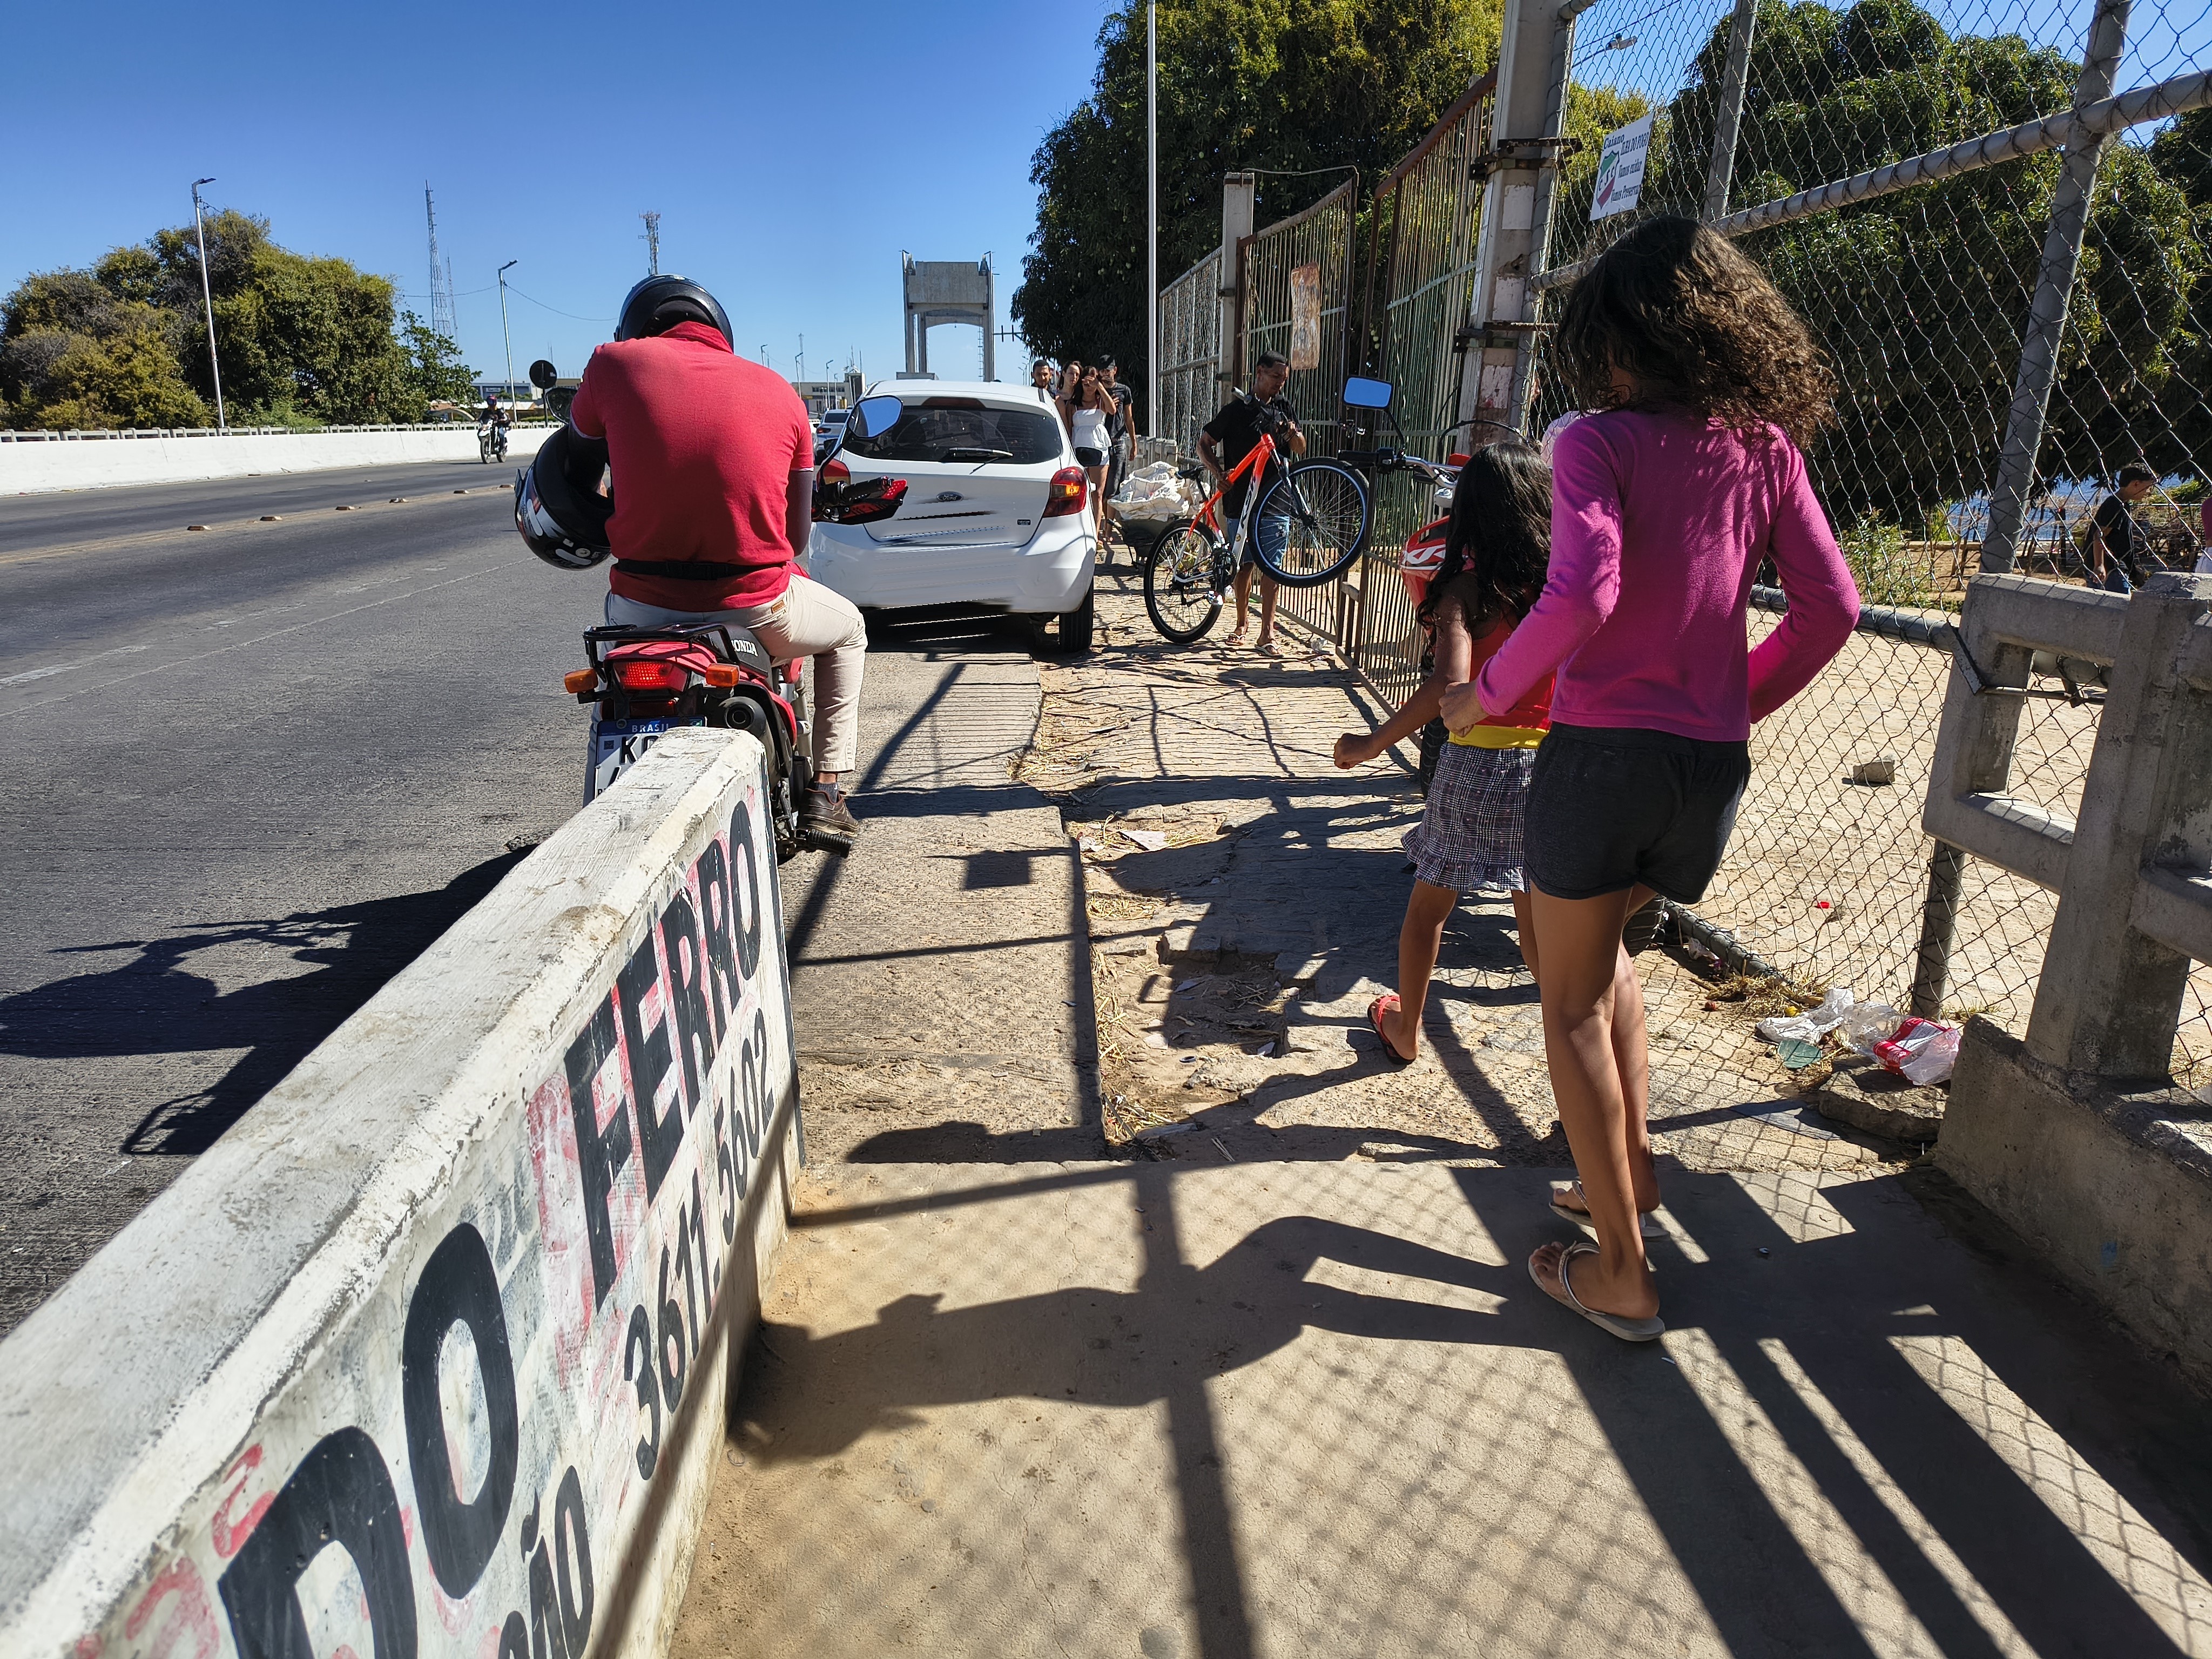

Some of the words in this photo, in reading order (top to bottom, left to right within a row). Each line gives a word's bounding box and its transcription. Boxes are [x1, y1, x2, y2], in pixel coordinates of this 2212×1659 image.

[1603, 134, 1625, 149] Caiano
[731, 639, 758, 657] ONDA
[563, 800, 761, 1315] FERRO
[498, 1465, 595, 1659] ÃO
